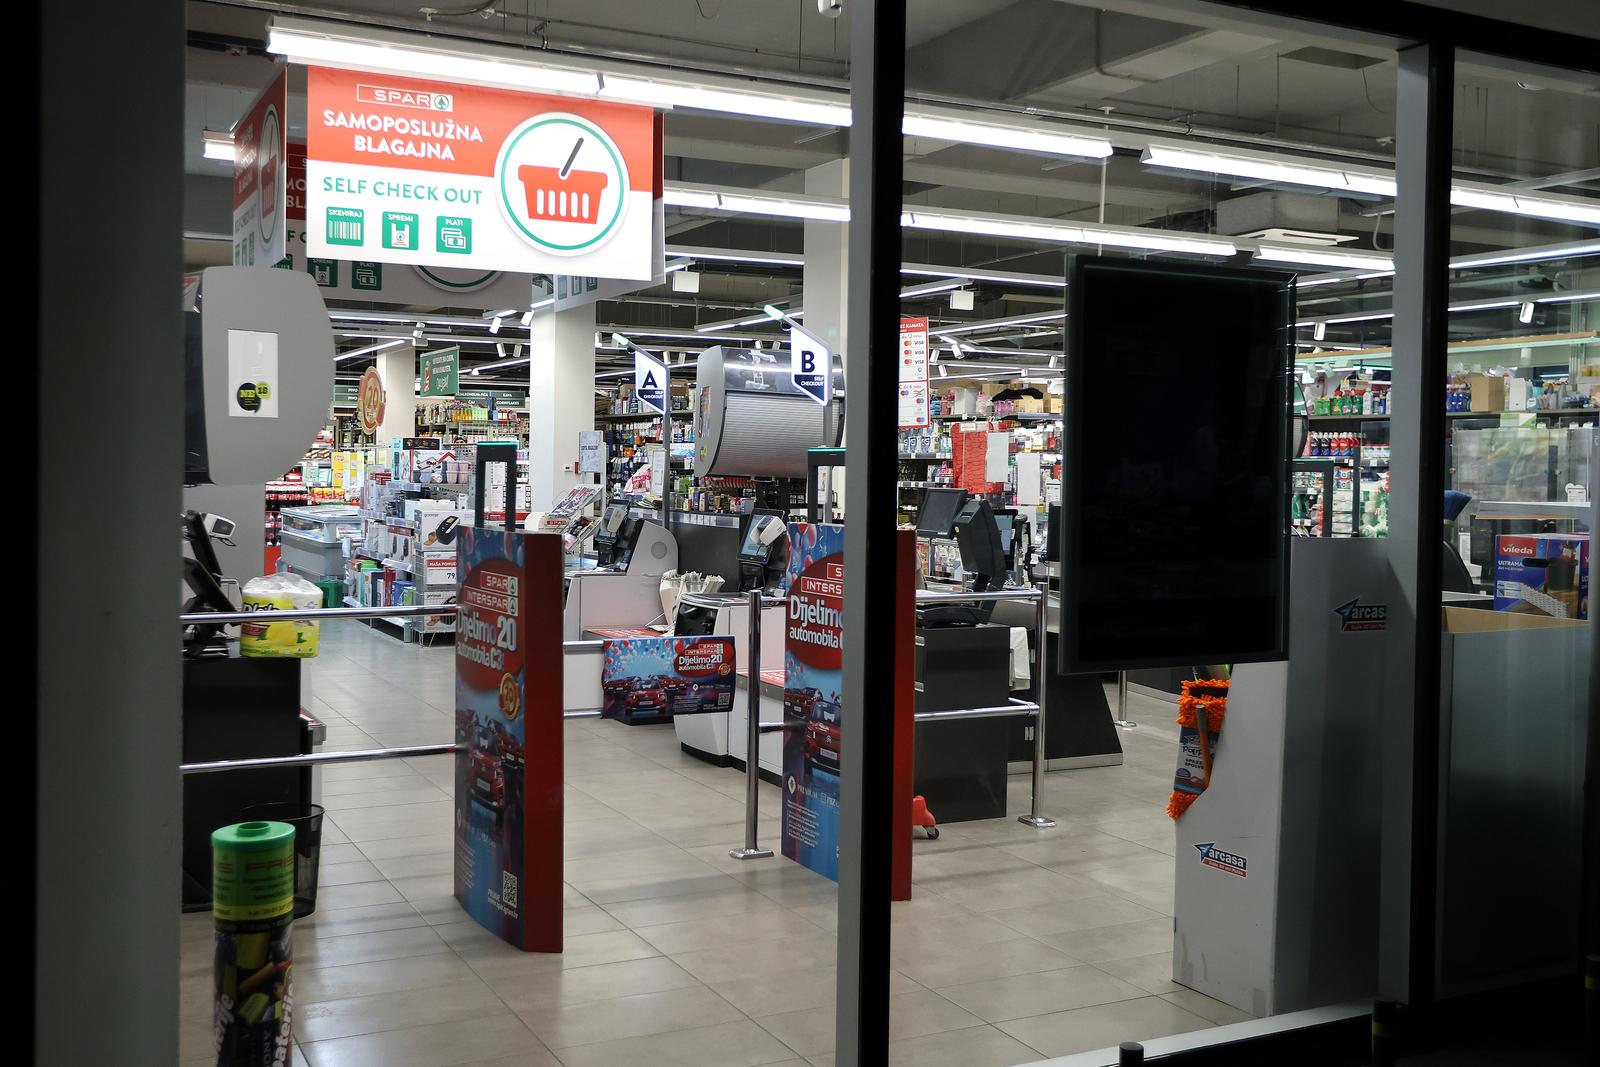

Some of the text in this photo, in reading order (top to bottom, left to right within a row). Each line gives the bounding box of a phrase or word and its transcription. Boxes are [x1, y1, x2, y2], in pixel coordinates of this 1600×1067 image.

[374, 89, 430, 106] SPAR
[323, 109, 484, 143] SAMOPOSLUŽNA
[354, 134, 456, 161] BLAGAJNA
[323, 176, 483, 205] SELF CHECK OUT
[328, 207, 463, 227] SKENIRAJ SPREMI PLATI
[801, 350, 815, 373] B
[642, 369, 658, 389] A
[1502, 545, 1533, 555] vileda
[1498, 559, 1523, 567] ULTRAMA
[486, 575, 508, 589] SPAR
[467, 591, 508, 610] INTERSPAR
[457, 609, 517, 652] Dijelimo 20
[789, 626, 839, 649] automobila
[457, 642, 490, 667] automobila
[678, 653, 723, 666] Dijelimo 20
[678, 663, 706, 671] automobila
[1209, 849, 1244, 867] arcasa
